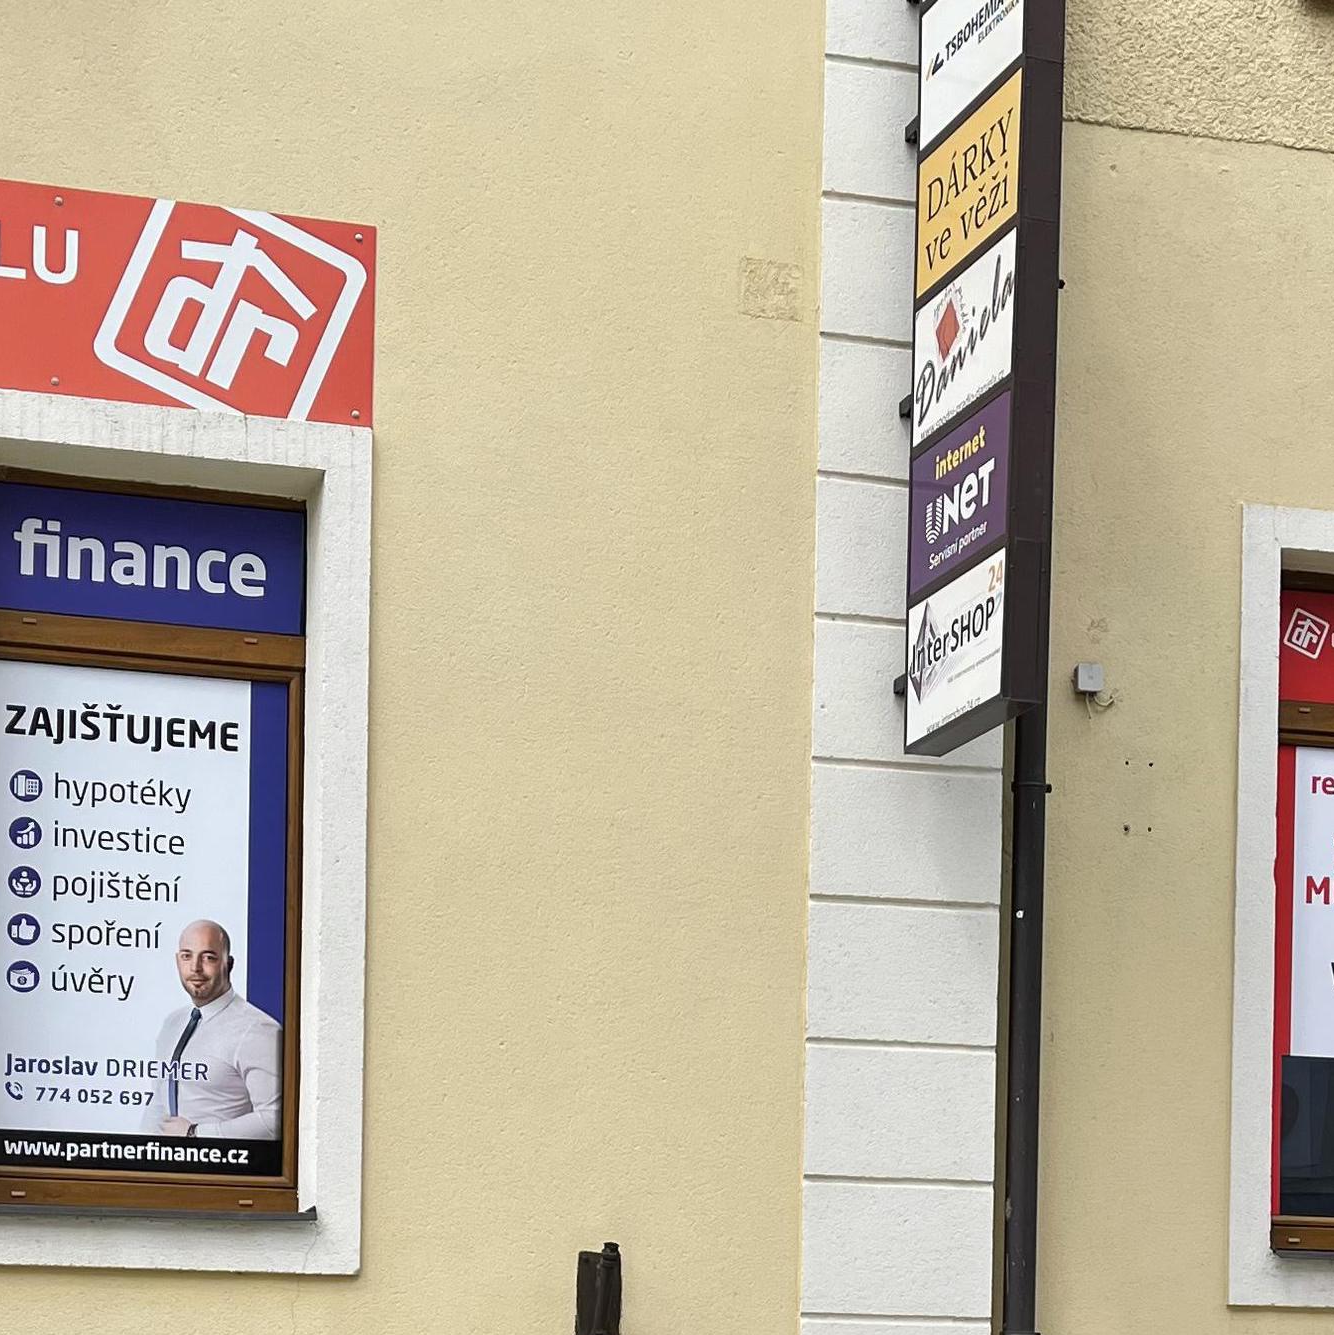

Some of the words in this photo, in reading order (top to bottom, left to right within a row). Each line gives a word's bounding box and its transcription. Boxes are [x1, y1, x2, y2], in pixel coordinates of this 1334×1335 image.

[927, 107, 1013, 223] DÁRKY
[926, 225, 952, 272] ve
[959, 161, 1010, 241] věži
[916, 254, 1015, 428] Daniela
[935, 424, 987, 480] internet
[958, 520, 988, 555] partner
[13, 517, 267, 598] finance
[988, 558, 1003, 593] 24
[912, 596, 995, 676] InterSHOP
[4, 703, 240, 752] ZAJIŠŤUJEME
[54, 772, 192, 814] hypotéky
[54, 820, 186, 855] investice
[51, 870, 182, 903] pojištění
[50, 920, 163, 951] spoření
[51, 963, 135, 1001] úvěry
[4, 1053, 99, 1078] Jaroslav
[106, 1057, 210, 1082] DRIEMER
[35, 1087, 72, 1103] 774
[77, 1088, 113, 1105] 052
[119, 1090, 155, 1106] 697
[3, 1139, 250, 1165] www.partnerfinance.cz
